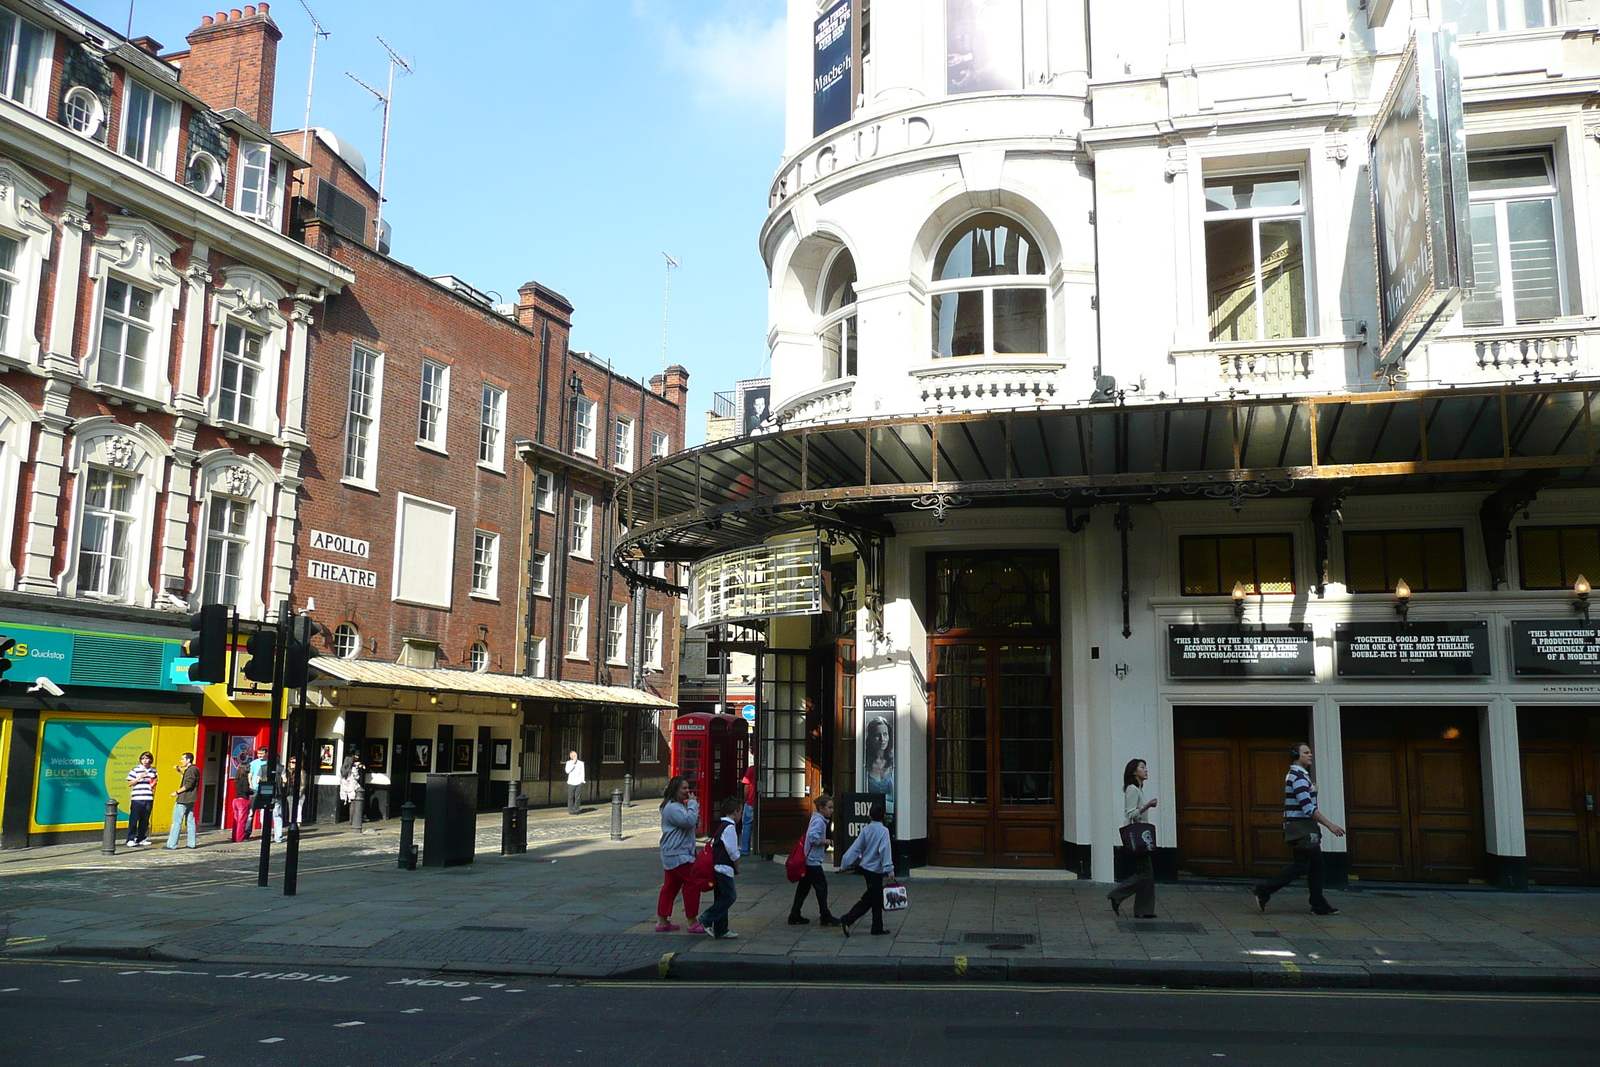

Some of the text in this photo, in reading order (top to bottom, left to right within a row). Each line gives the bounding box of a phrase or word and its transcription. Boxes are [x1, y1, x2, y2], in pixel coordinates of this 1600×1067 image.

[814, 55, 851, 93] Macbeth
[314, 533, 366, 556] APOLLO
[312, 562, 374, 587] THEATRE
[31, 649, 65, 660] Quickstop
[865, 698, 894, 708] Macbeth
[45, 769, 98, 777] BUDGENS
[216, 971, 350, 983] RIGHT
[386, 978, 506, 988] LOOK
